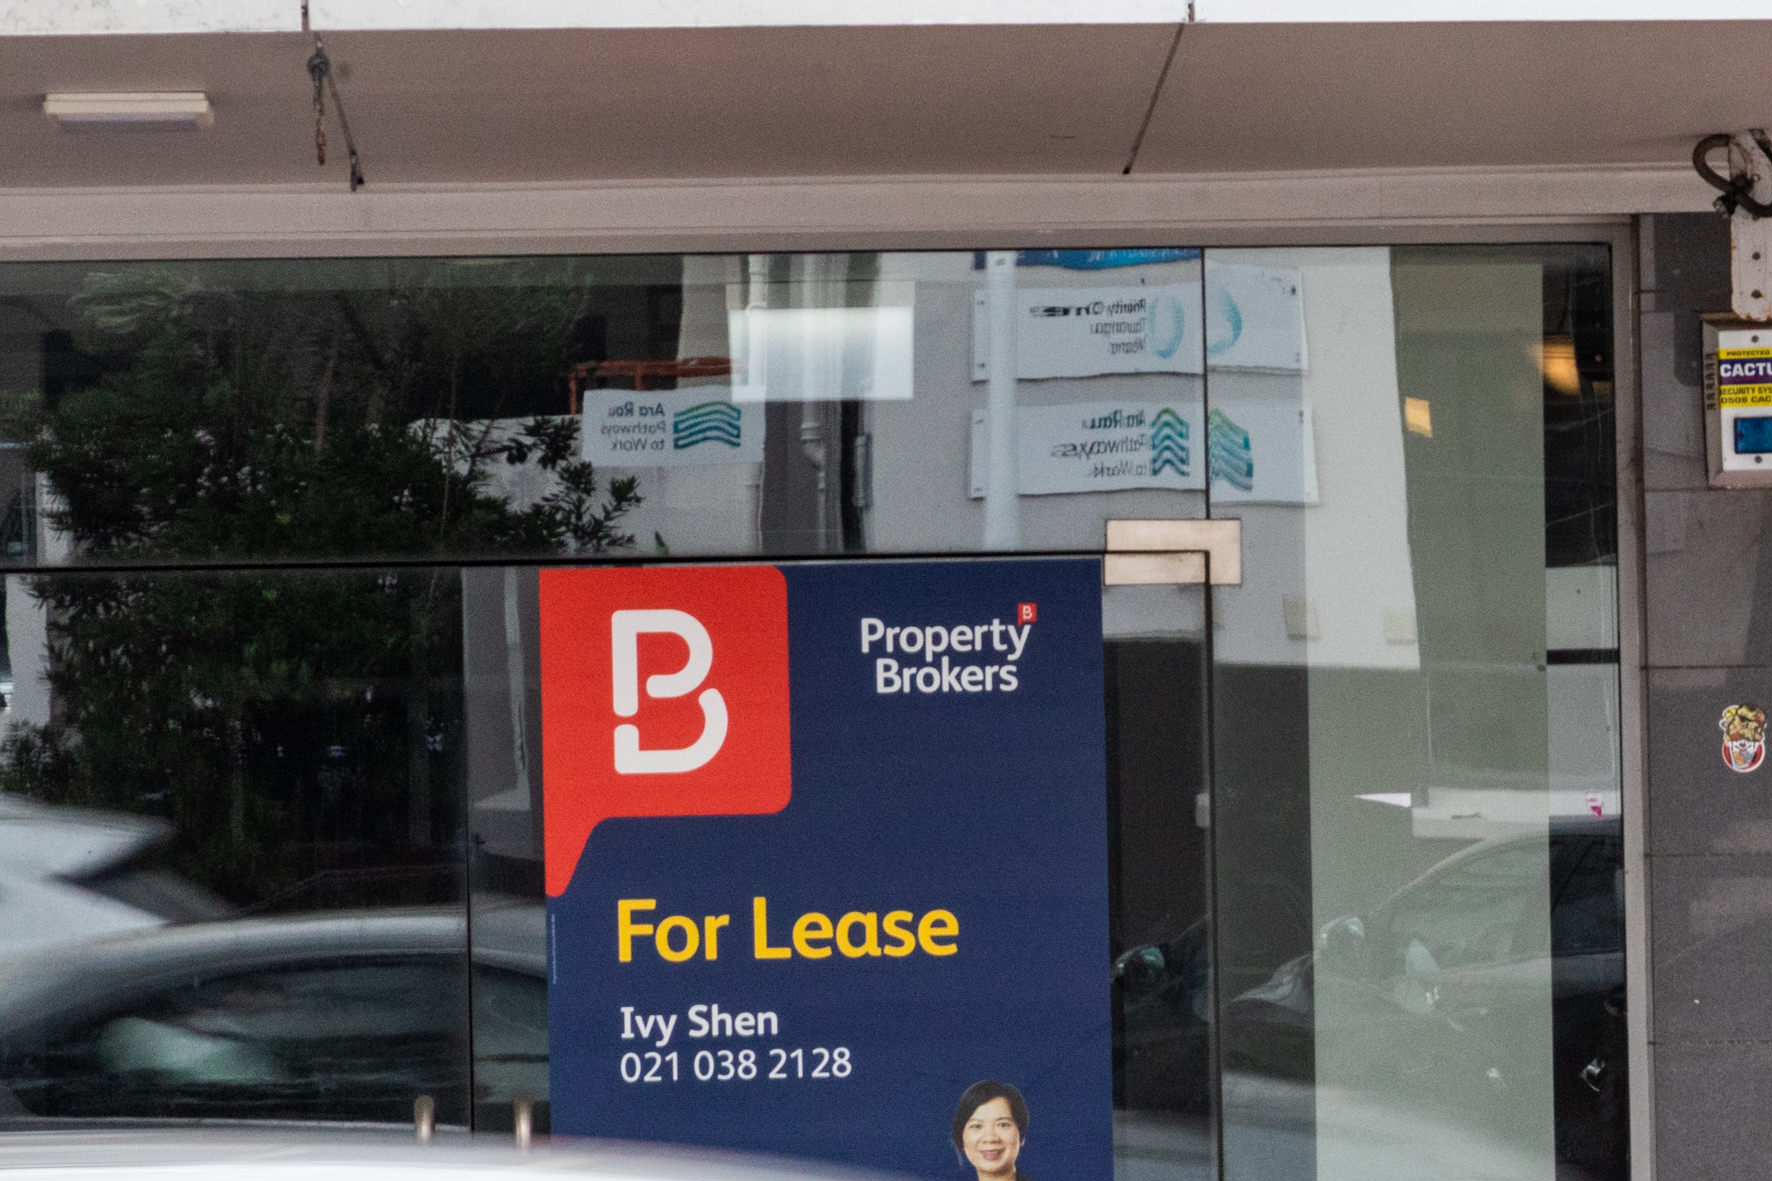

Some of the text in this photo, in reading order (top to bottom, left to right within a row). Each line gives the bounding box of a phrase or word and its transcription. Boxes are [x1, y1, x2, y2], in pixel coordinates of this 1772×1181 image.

[860, 617, 1031, 661] Property
[876, 658, 1018, 694] Brokers
[618, 898, 729, 963] For
[753, 896, 959, 960] Lease
[621, 1004, 778, 1047] Ivy Shen
[621, 1046, 852, 1083] 021 038 2128
